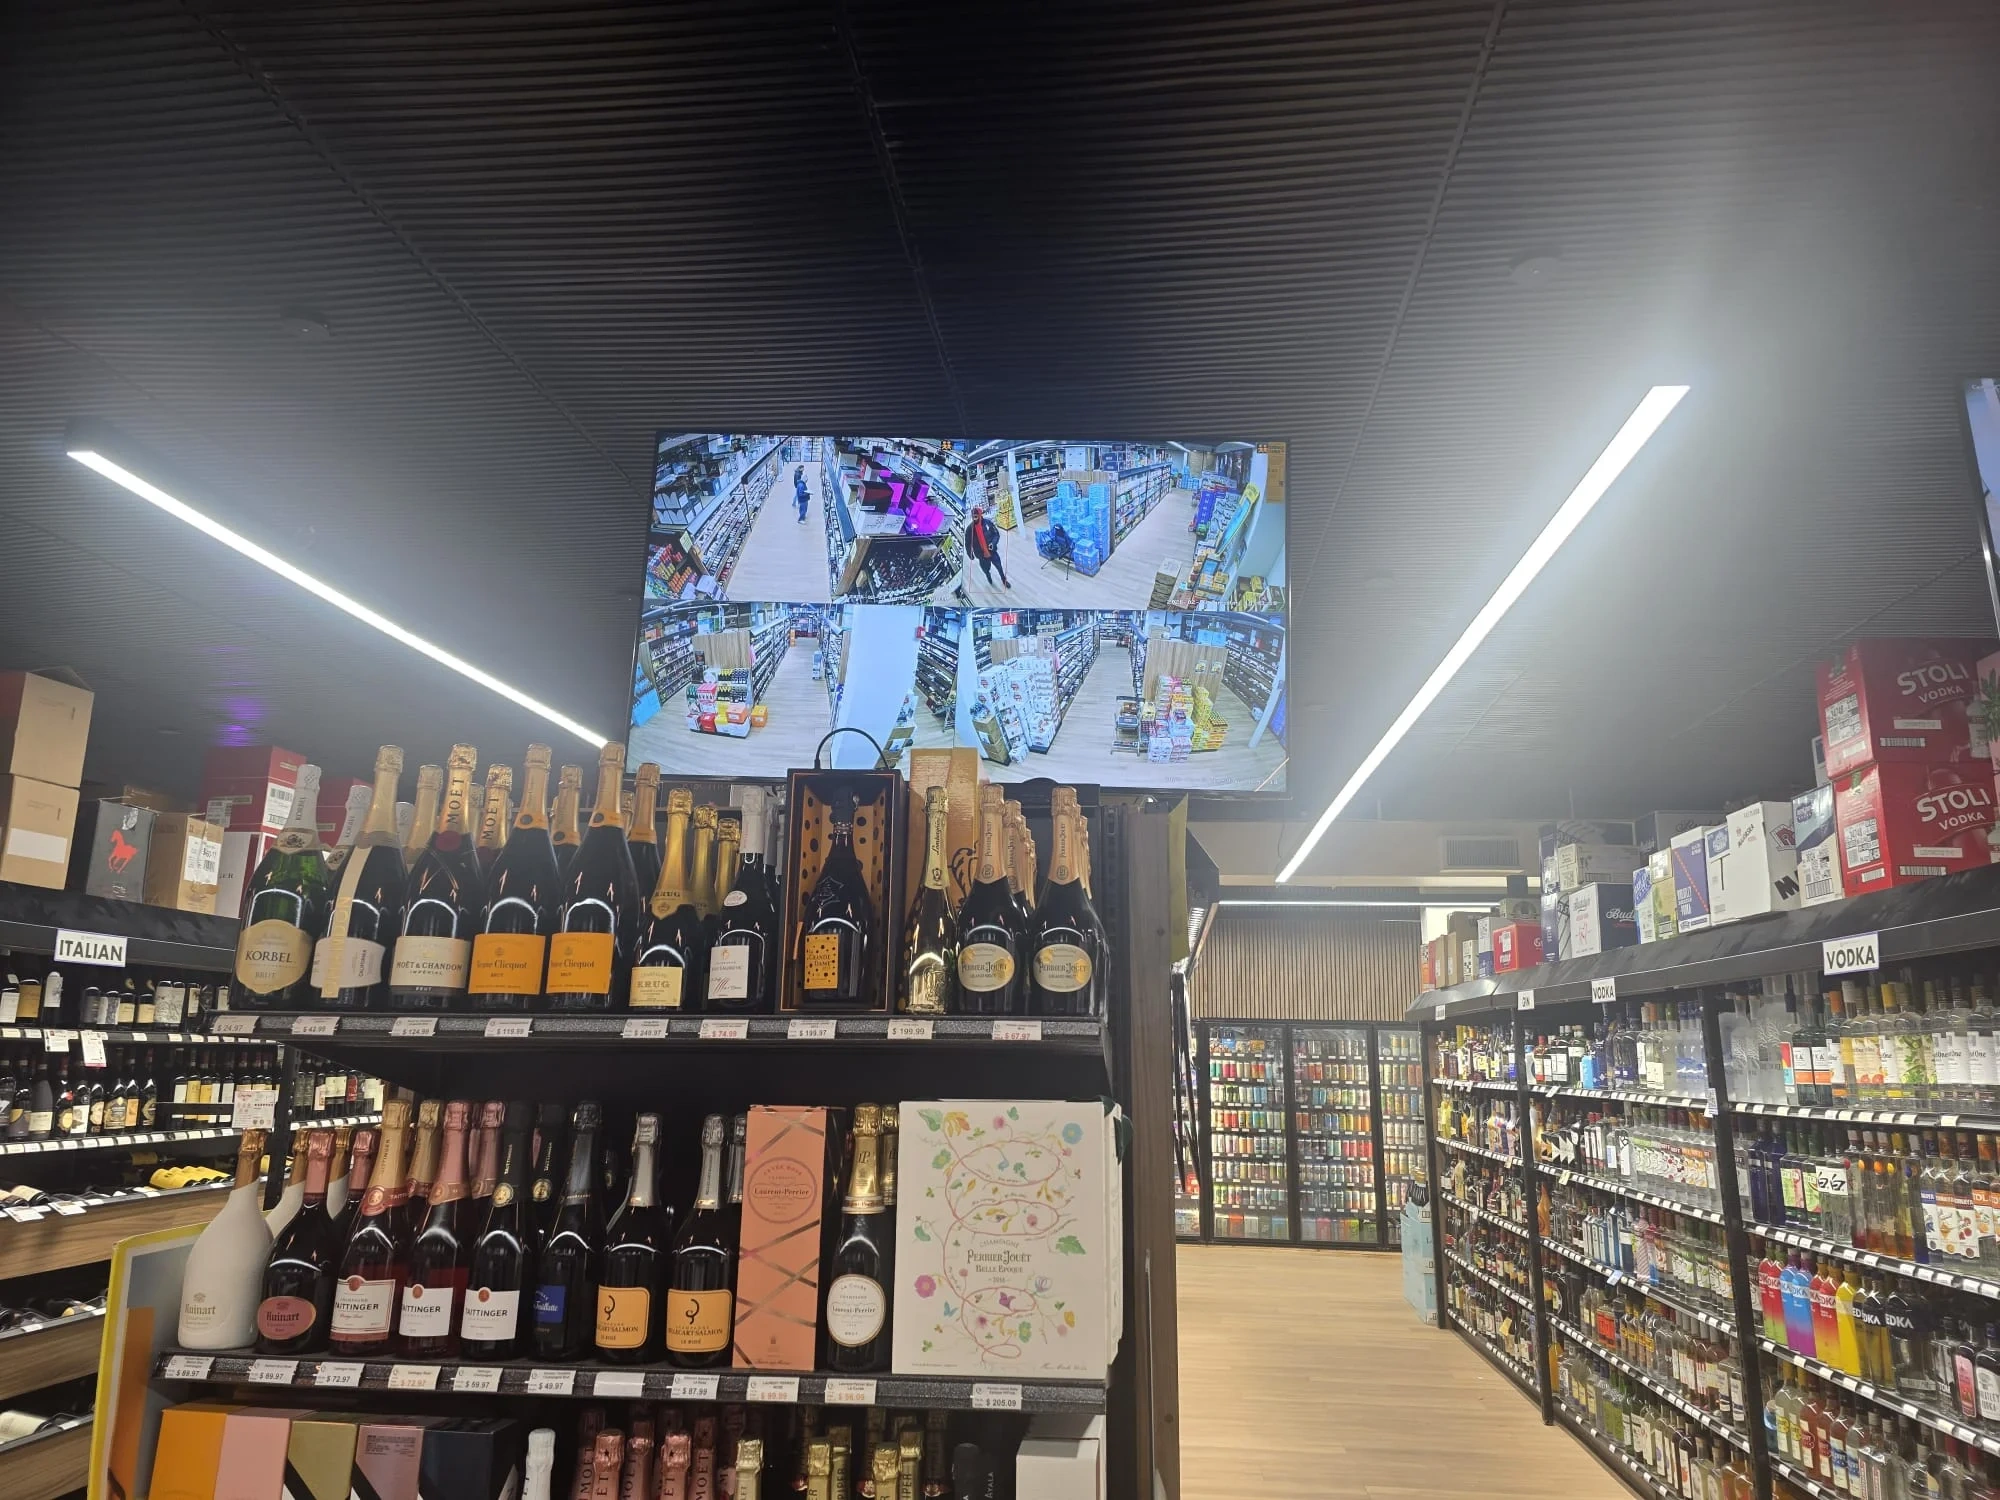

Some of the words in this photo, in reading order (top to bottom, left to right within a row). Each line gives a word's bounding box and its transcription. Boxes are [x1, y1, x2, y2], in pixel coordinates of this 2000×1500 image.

[1897, 663, 1970, 696] STOLI
[1918, 685, 1965, 703] VODKA
[1916, 788, 1991, 822] STOLI
[1938, 811, 1986, 831] VODKA
[59, 939, 122, 962] ITALIAN
[245, 950, 293, 963] KORBEL
[1826, 945, 1876, 970] VODKA
[421, 962, 462, 971] CHANDON
[494, 960, 528, 970] Clicquot
[637, 980, 671, 988] KRUG
[1592, 986, 1615, 999] VODKA
[185, 1303, 216, 1315] Ruinart
[266, 1310, 300, 1321] Ruinart
